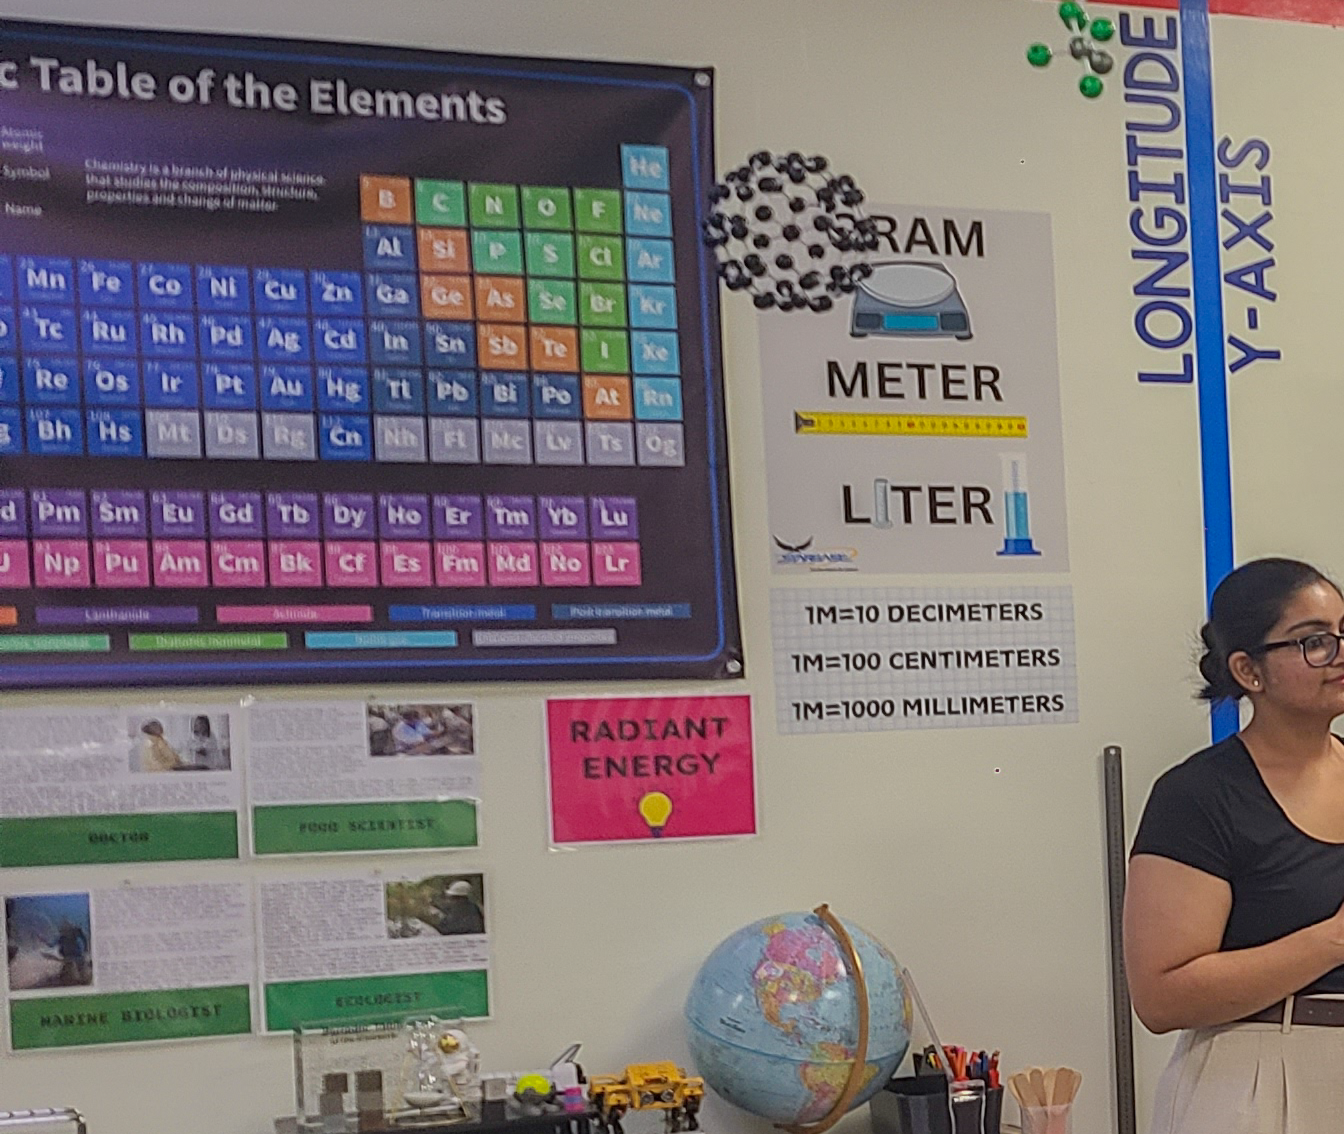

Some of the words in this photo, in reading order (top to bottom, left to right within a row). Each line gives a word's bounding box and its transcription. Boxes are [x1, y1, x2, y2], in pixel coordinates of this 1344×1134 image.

[30, 56, 156, 99] Table
[168, 68, 215, 104] of
[223, 71, 298, 112] the
[310, 77, 507, 125] Elements
[1119, 13, 1194, 384] LONGITUDE
[1217, 136, 1281, 373] Y-AXIS
[27, 269, 66, 290] Mn
[149, 275, 182, 296] Co
[210, 276, 237, 298] Ni
[265, 280, 297, 300] Cu
[93, 320, 127, 341] Ru
[151, 323, 186, 344] Rh
[210, 325, 243, 347] Pd
[267, 327, 302, 352] Ag
[324, 328, 357, 350] Cd
[827, 361, 1003, 402] METER
[99, 420, 133, 443] Hs
[38, 504, 81, 523] Pm
[162, 504, 194, 524] Eu
[219, 503, 253, 524] Gd
[842, 478, 994, 528] LITER
[105, 554, 138, 573] Pu
[160, 555, 200, 574] Am
[806, 604, 879, 625] 1M=10
[888, 603, 1043, 624] DECIMETERS
[791, 652, 880, 673] 1M=100
[889, 648, 1060, 671] CENTIMETERS
[792, 700, 894, 722] 1M=1000
[902, 695, 1064, 718] MILLIMETERS
[570, 716, 729, 744] RADIANT
[582, 752, 721, 781] ENERGY
